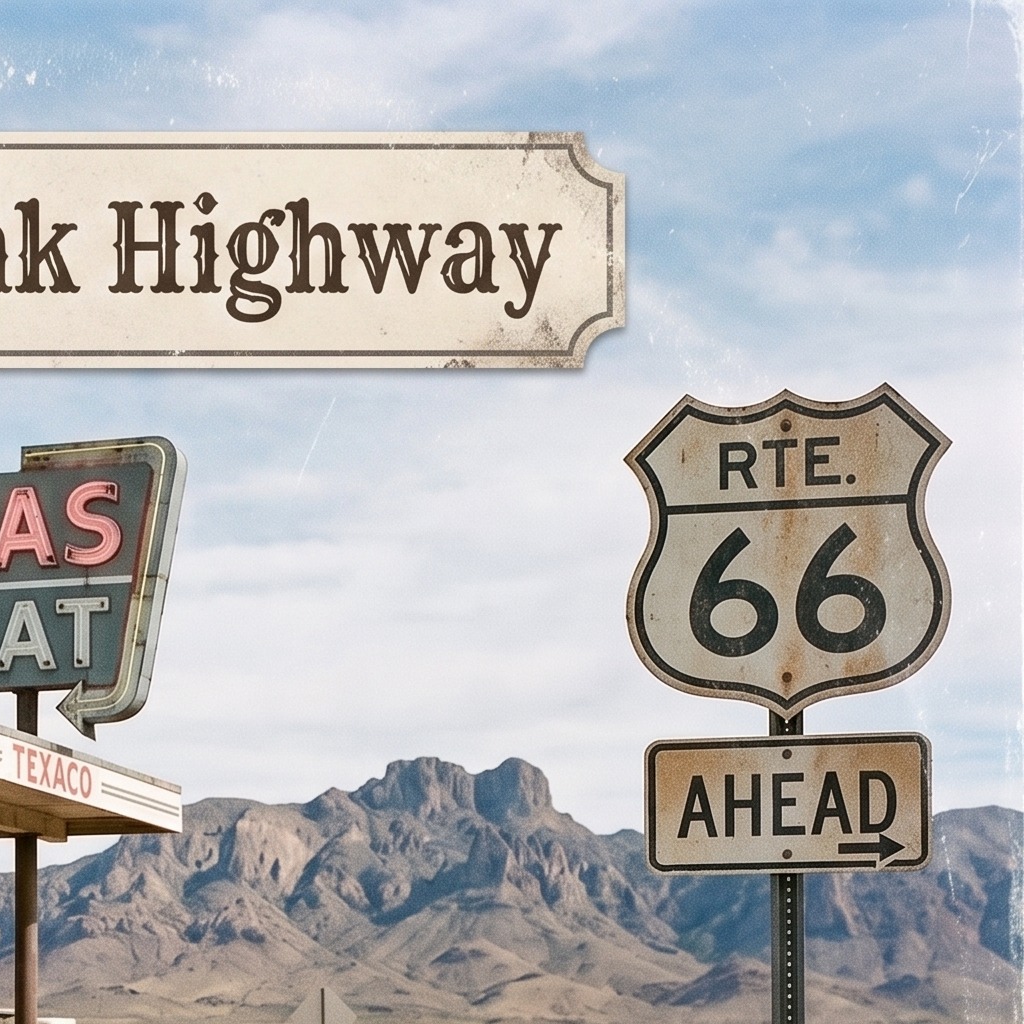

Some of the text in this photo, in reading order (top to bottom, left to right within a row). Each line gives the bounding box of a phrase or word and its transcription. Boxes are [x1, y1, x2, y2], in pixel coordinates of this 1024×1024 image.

[718, 436, 857, 491] RTE.
[689, 522, 887, 658] 66
[12, 742, 93, 799] TEXACO
[677, 770, 898, 839] AHEAD
